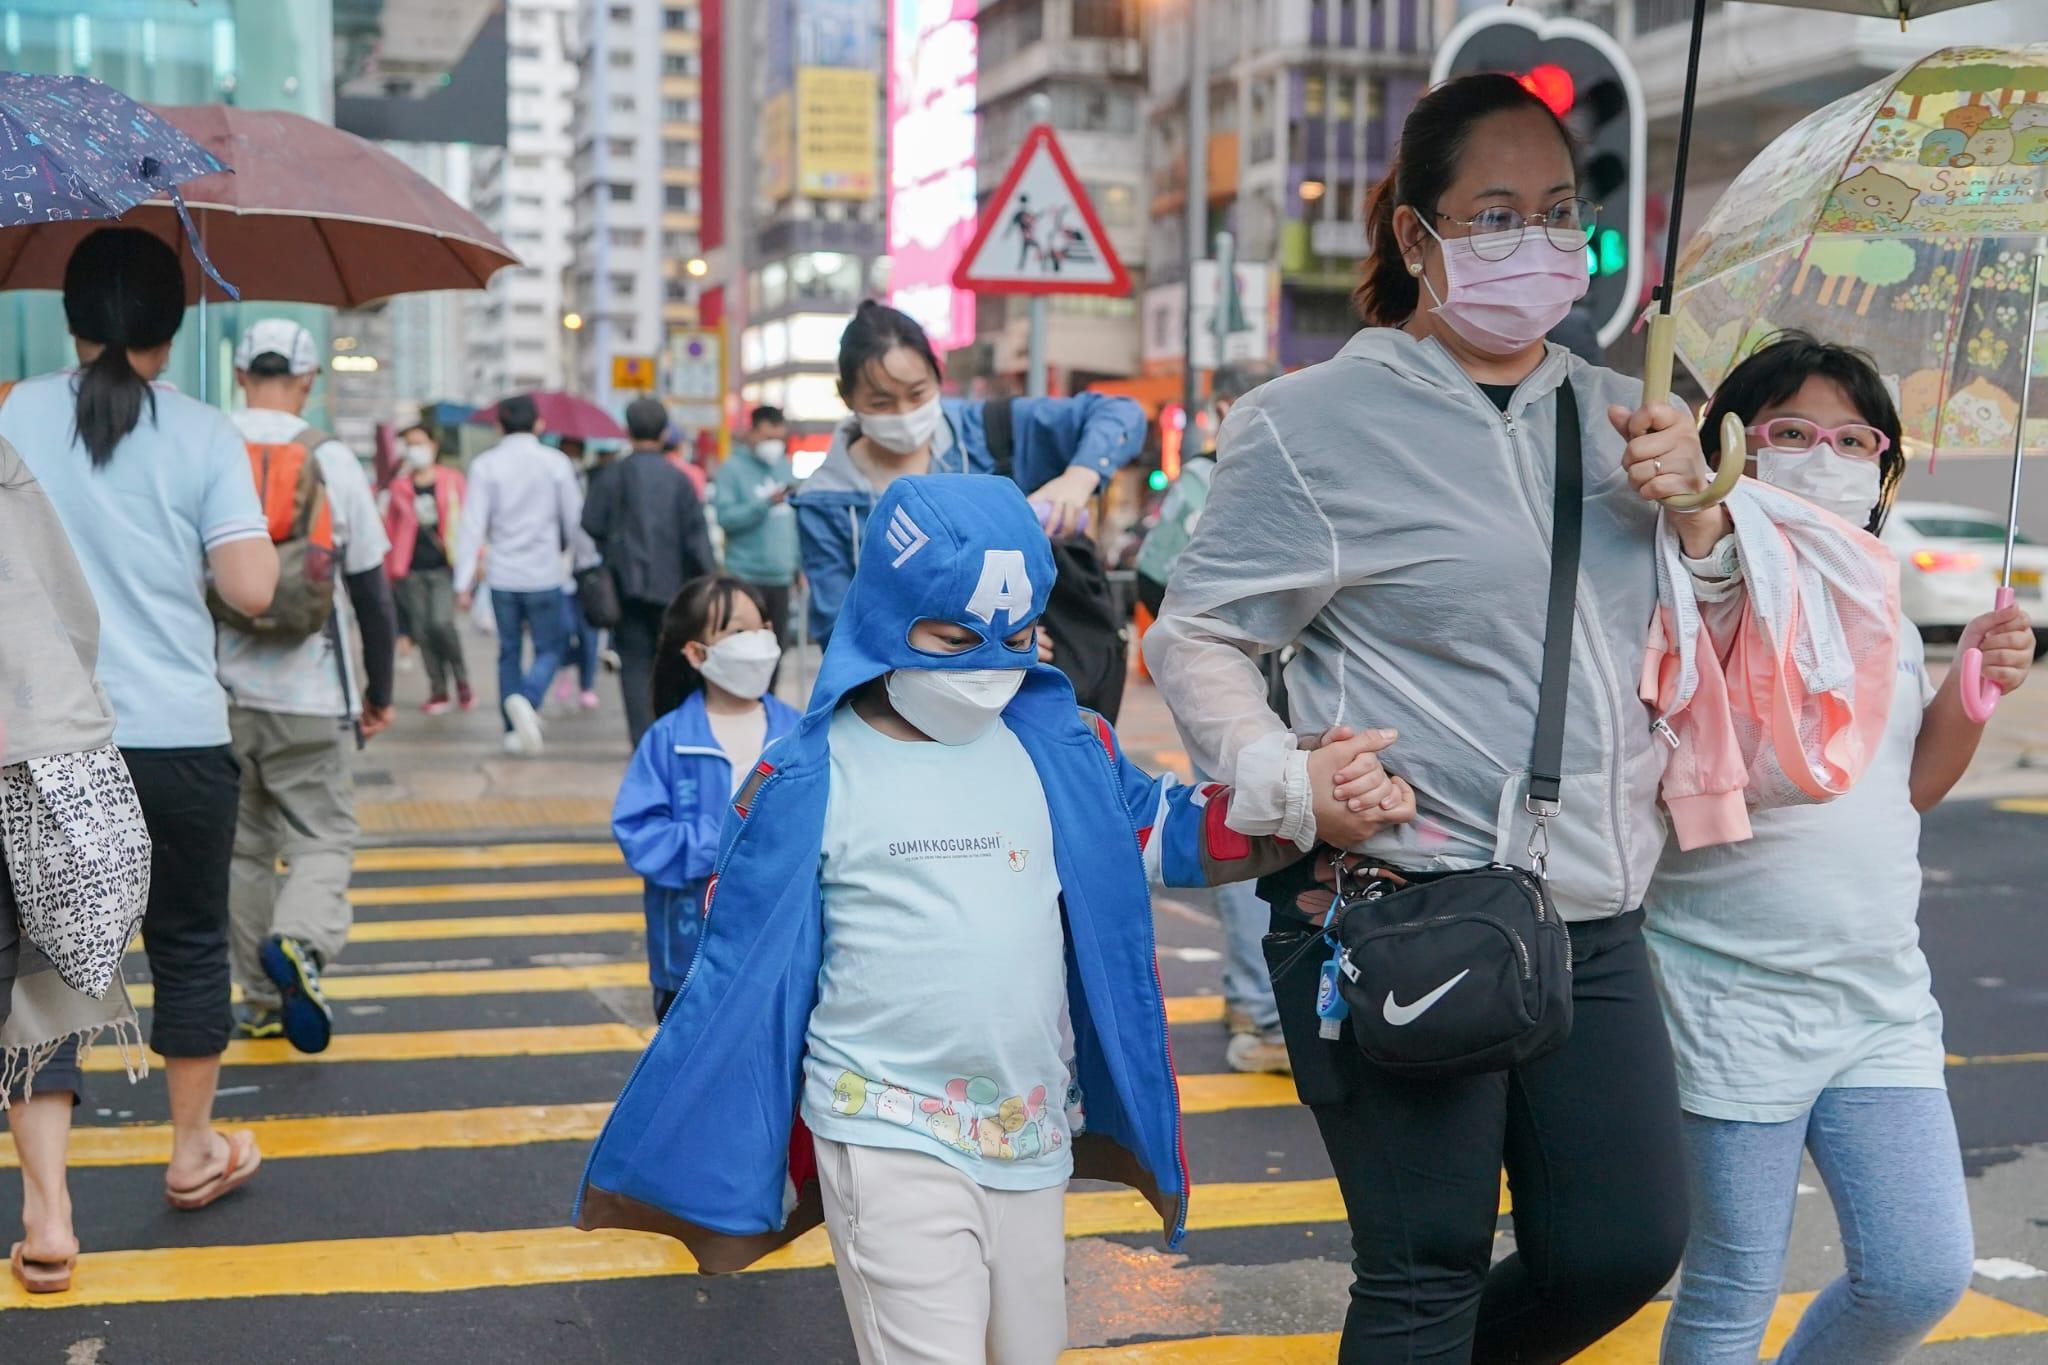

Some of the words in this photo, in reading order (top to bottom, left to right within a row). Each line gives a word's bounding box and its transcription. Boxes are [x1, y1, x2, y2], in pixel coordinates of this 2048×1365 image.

[1930, 169, 2033, 191] Sumikko
[1945, 187, 2031, 206] gurashi
[965, 549, 1033, 626] A
[888, 836, 1000, 856] SUMIKKOGURASHI
